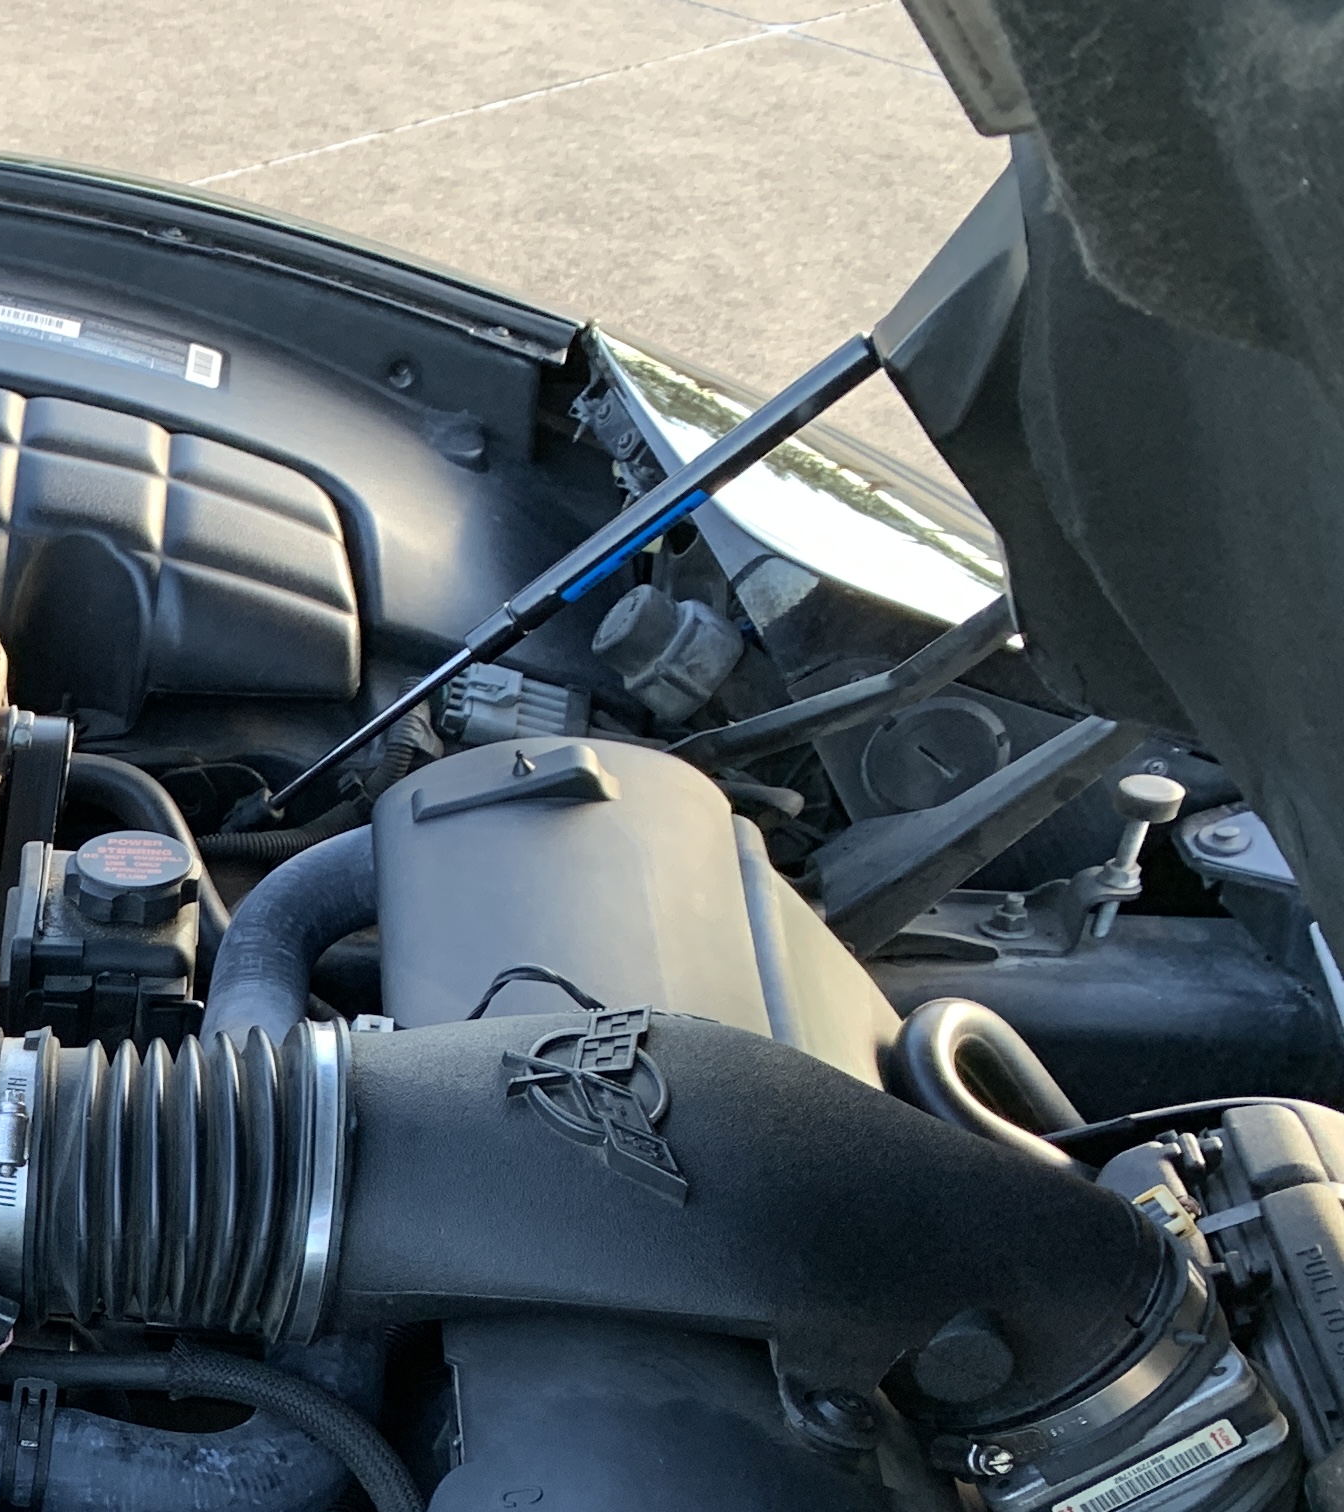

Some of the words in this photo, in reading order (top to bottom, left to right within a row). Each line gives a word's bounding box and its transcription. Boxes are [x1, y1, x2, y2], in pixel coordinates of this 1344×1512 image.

[107, 838, 163, 846] POWER
[97, 847, 172, 856] STEERING
[1216, 1426, 1233, 1446] FLOW
